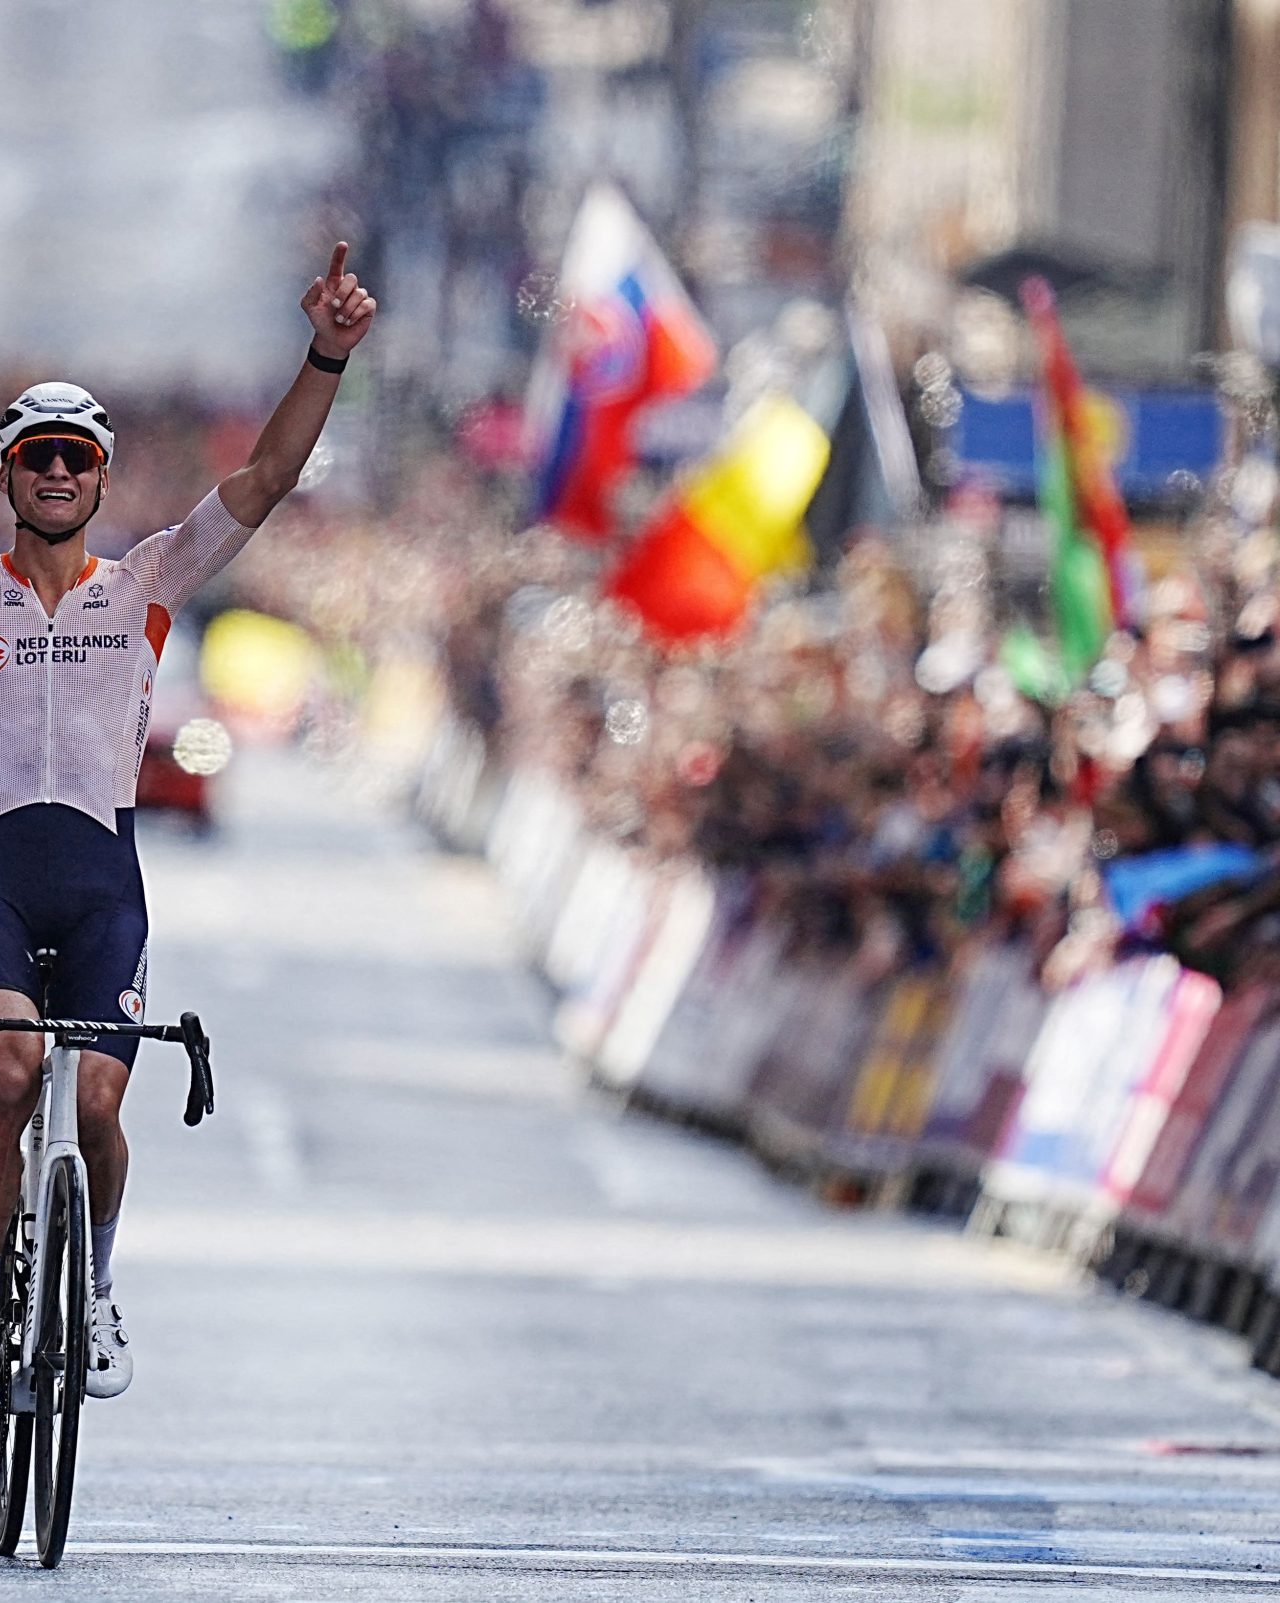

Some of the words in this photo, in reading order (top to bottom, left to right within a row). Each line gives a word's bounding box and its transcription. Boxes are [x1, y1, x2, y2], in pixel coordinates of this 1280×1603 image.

[82, 599, 109, 610] AGU
[16, 634, 129, 650] NEDERLANDSE
[16, 650, 87, 665] LOTERIJ
